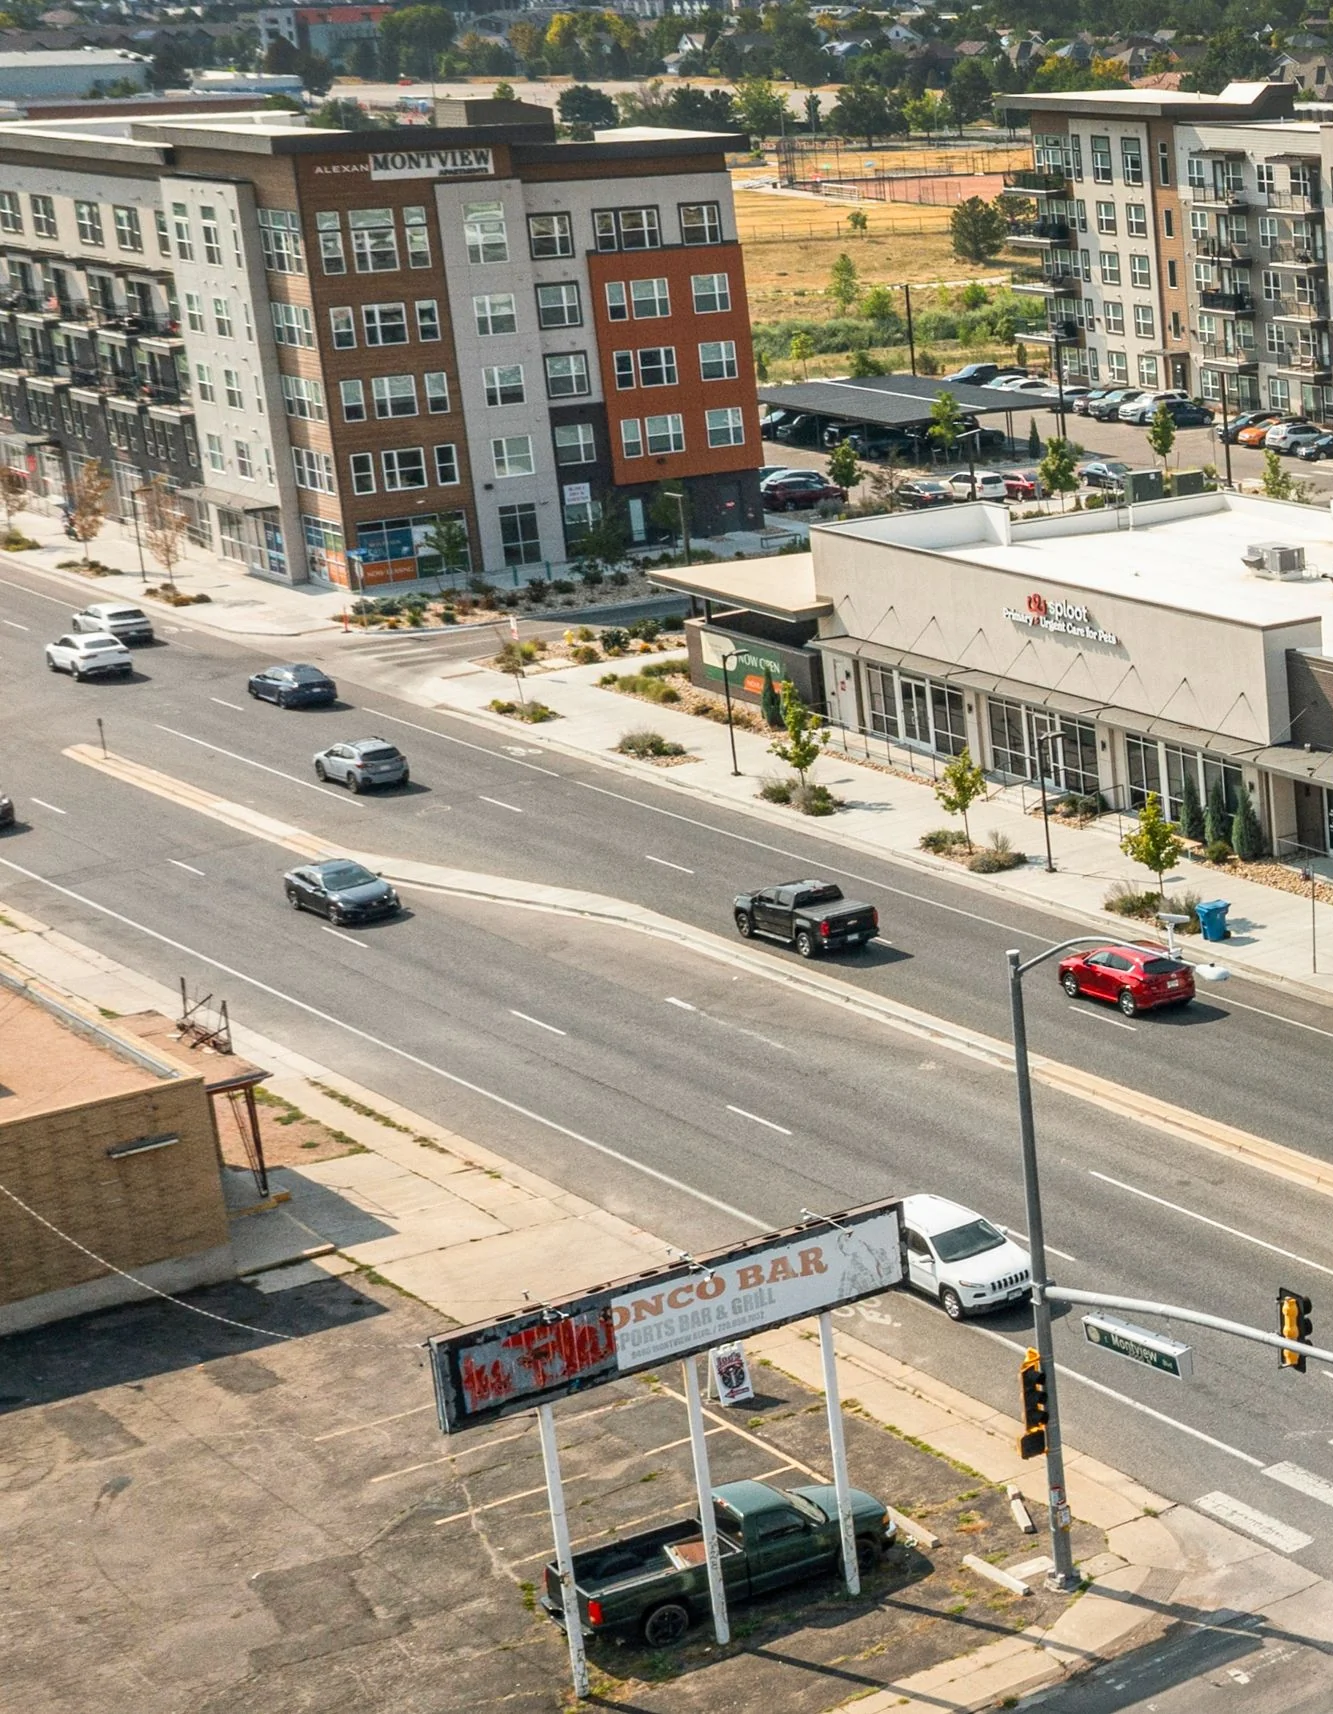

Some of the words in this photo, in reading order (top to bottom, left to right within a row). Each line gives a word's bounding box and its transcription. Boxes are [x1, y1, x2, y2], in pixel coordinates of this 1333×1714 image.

[314, 163, 370, 174] ALEXAN
[372, 149, 490, 172] MONTVIEW
[1048, 600, 1088, 622] sploot
[1003, 608, 1033, 626] Primary
[1066, 623, 1085, 637] Care
[1086, 626, 1097, 640] for
[1099, 630, 1117, 644] Pets
[738, 654, 758, 668] NOW
[611, 1276, 726, 1330] ONCO
[736, 1247, 828, 1290] BAR
[678, 1306, 712, 1333] BAR
[715, 1304, 728, 1320] &
[730, 1287, 776, 1315] GRILL
[1110, 1333, 1157, 1362] Montview
